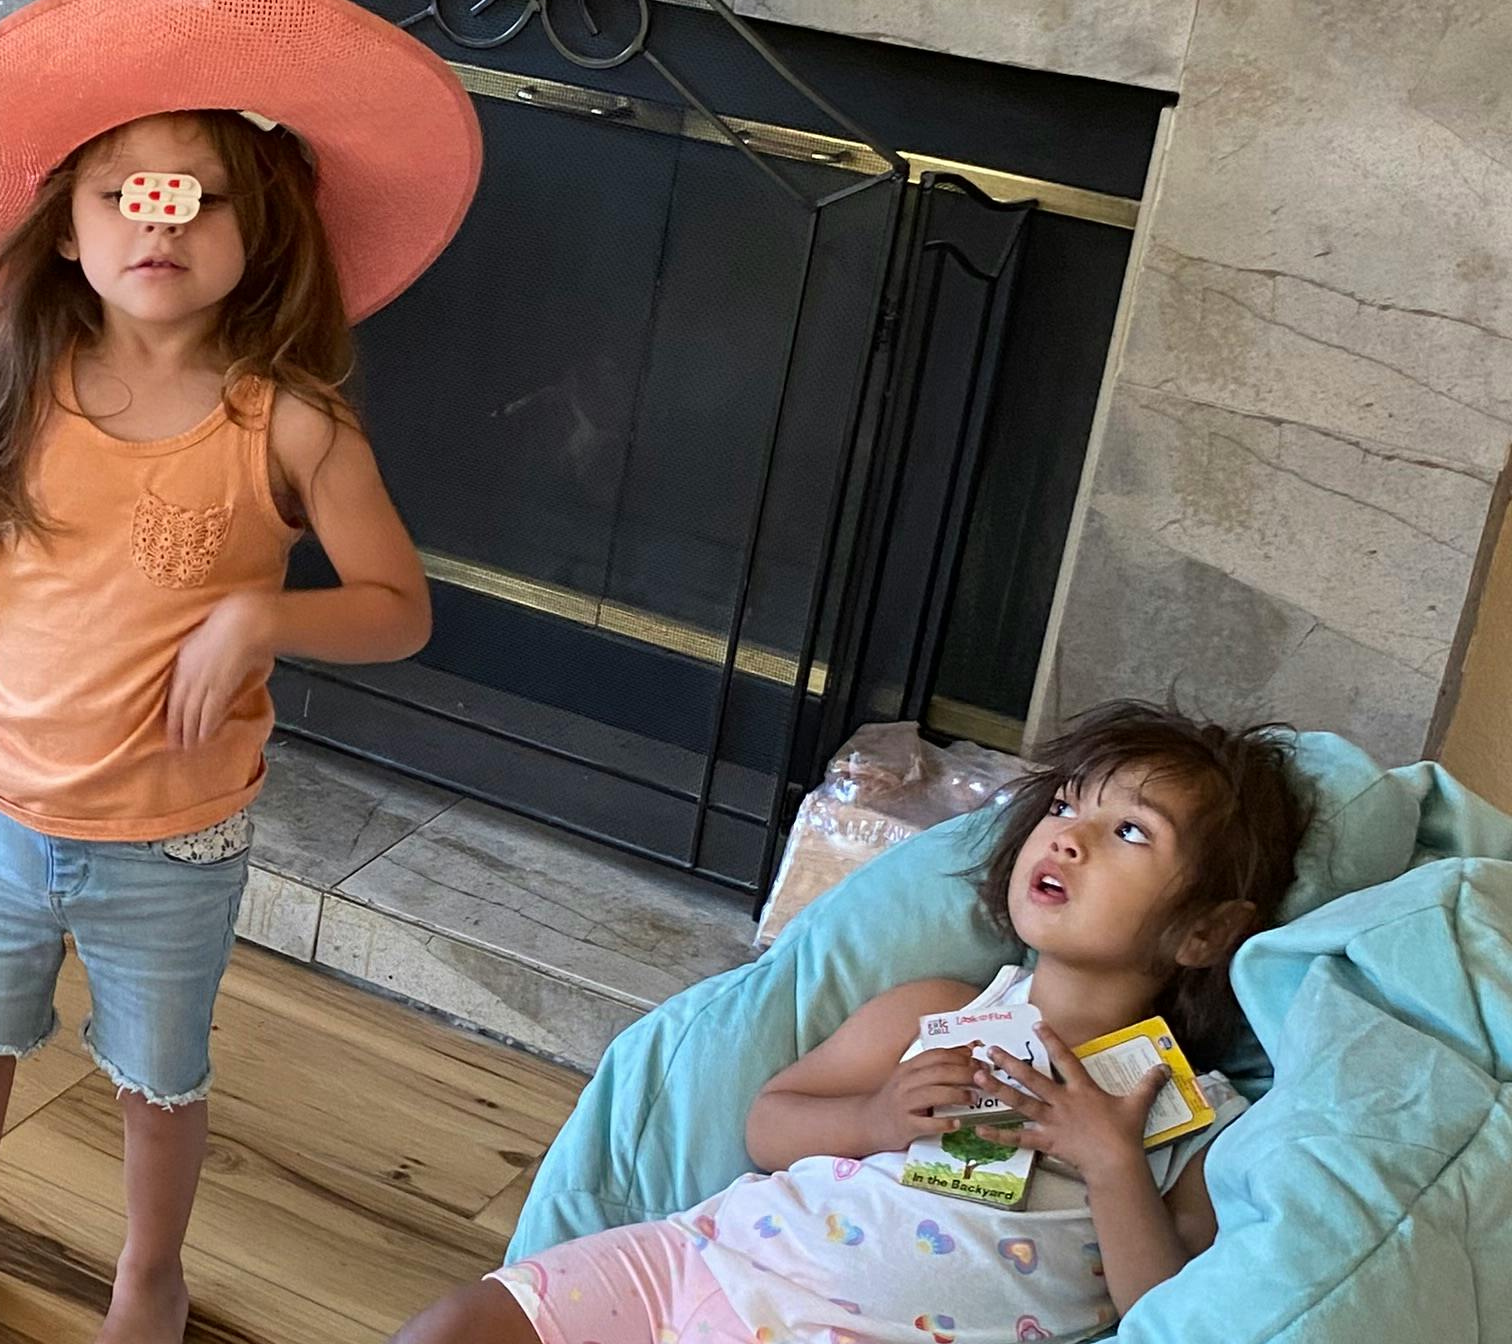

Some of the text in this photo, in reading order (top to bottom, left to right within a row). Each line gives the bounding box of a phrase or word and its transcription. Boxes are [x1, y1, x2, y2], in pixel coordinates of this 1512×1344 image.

[989, 1011, 1012, 1021] Find
[912, 1172, 1015, 1200] In the Backyard
